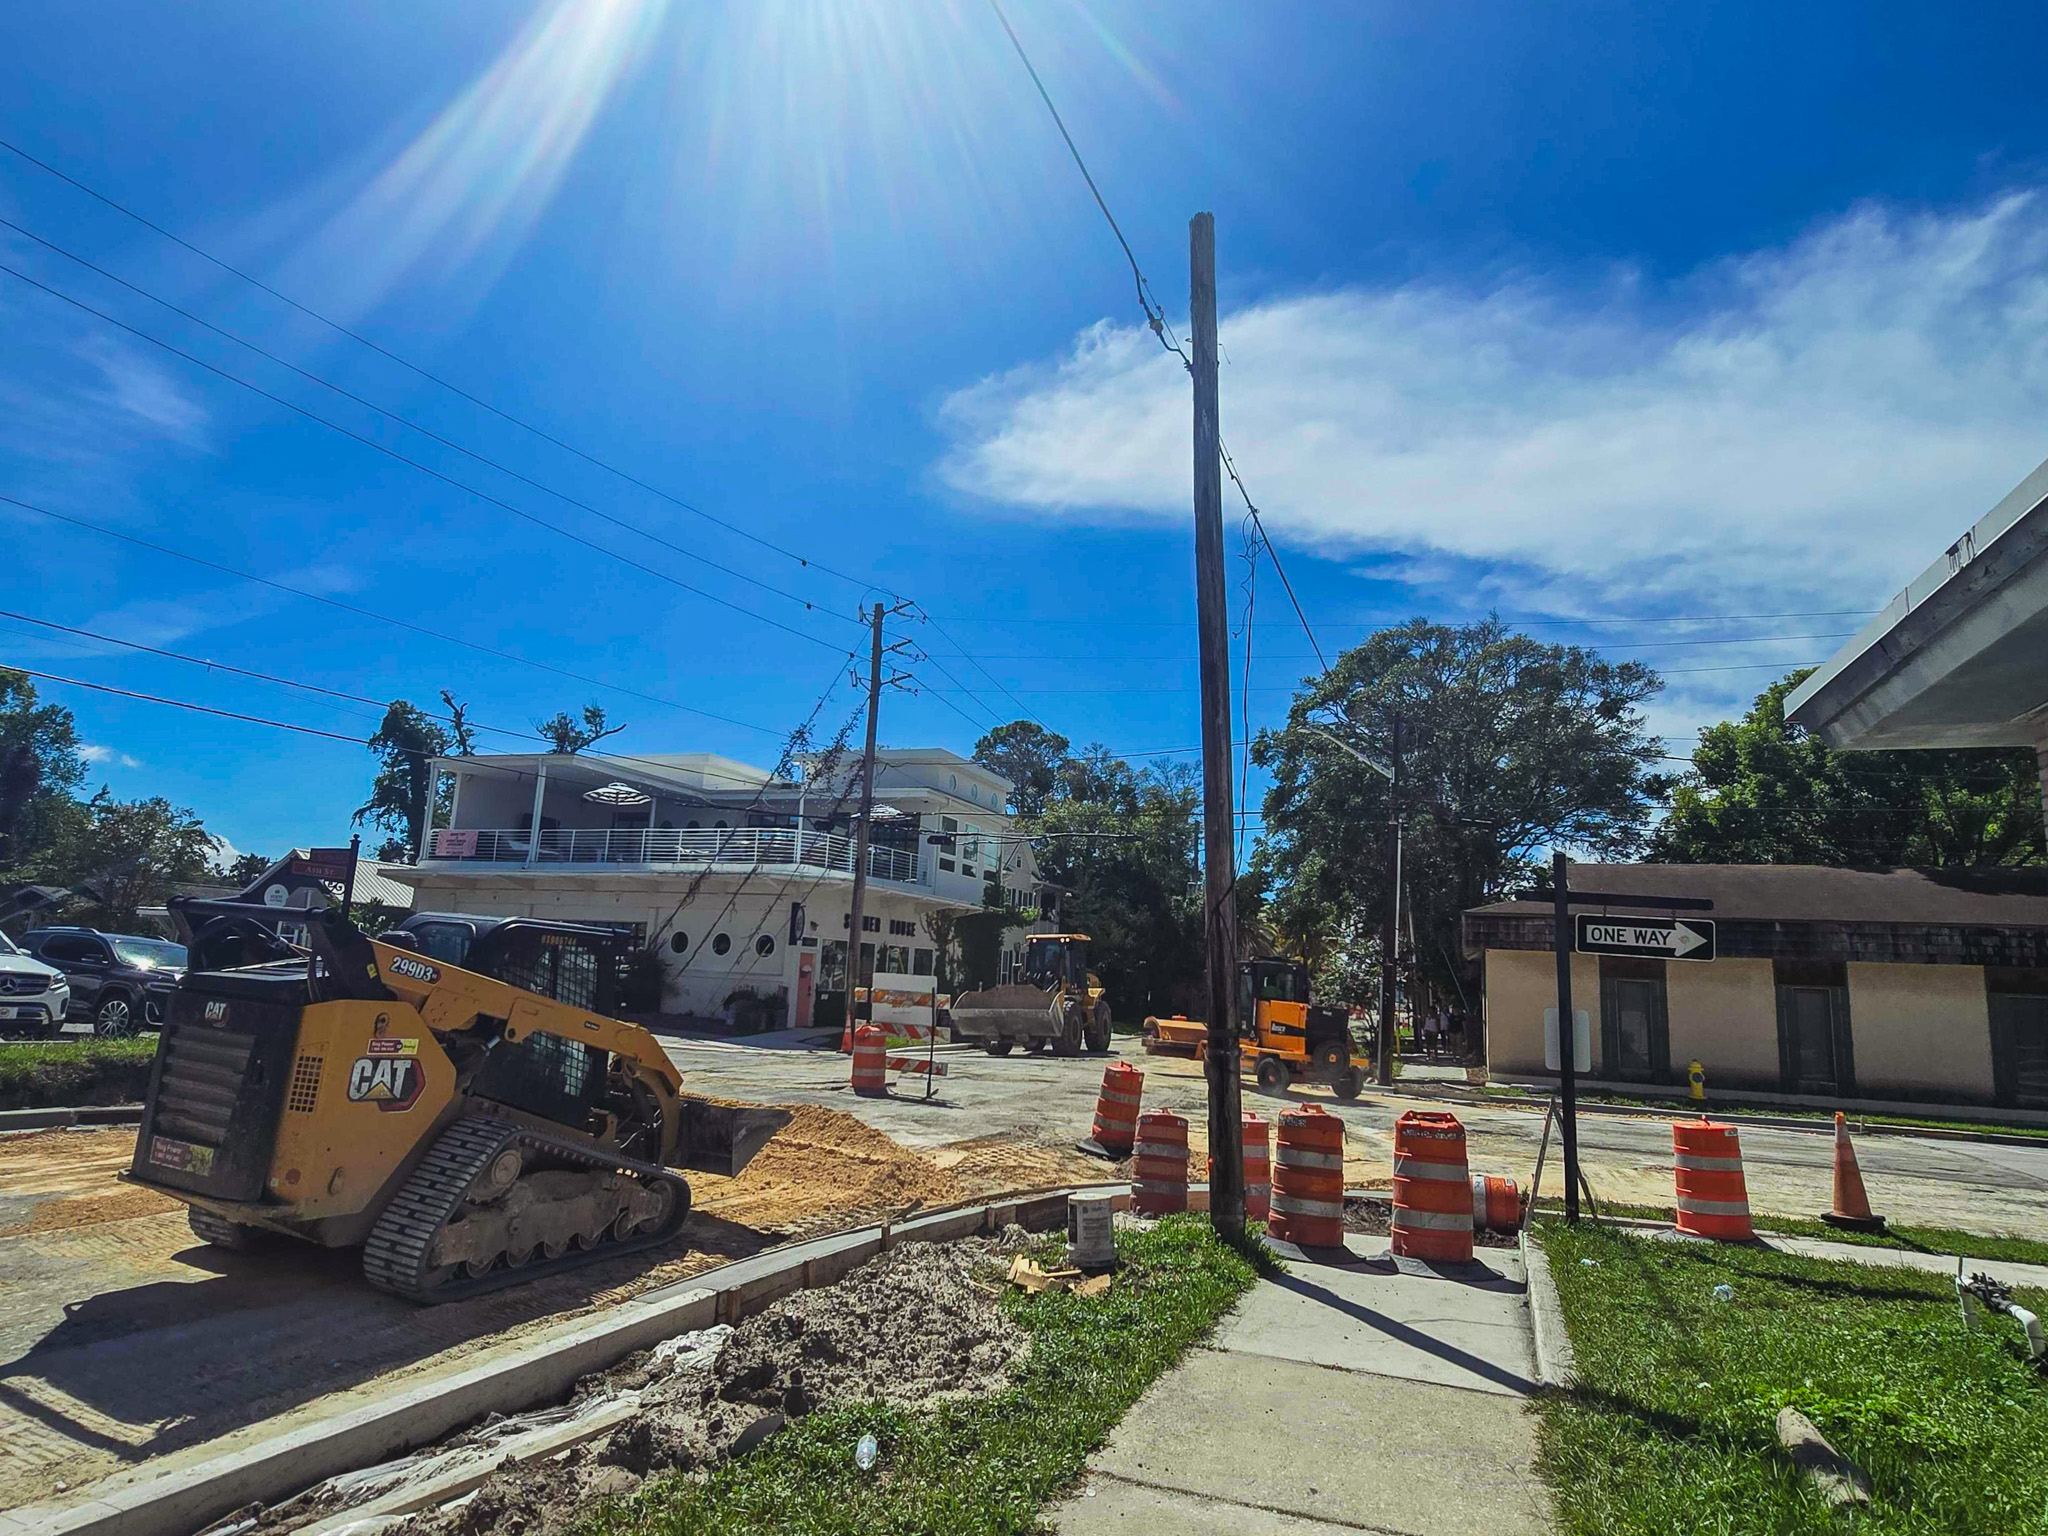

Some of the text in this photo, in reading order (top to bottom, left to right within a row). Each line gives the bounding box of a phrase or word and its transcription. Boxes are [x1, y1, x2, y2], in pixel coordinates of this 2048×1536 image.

[1591, 927, 1672, 946] ONE WAY
[390, 956, 433, 981] 299D3
[204, 1001, 227, 1020] CAT
[348, 1058, 412, 1100] CAT
